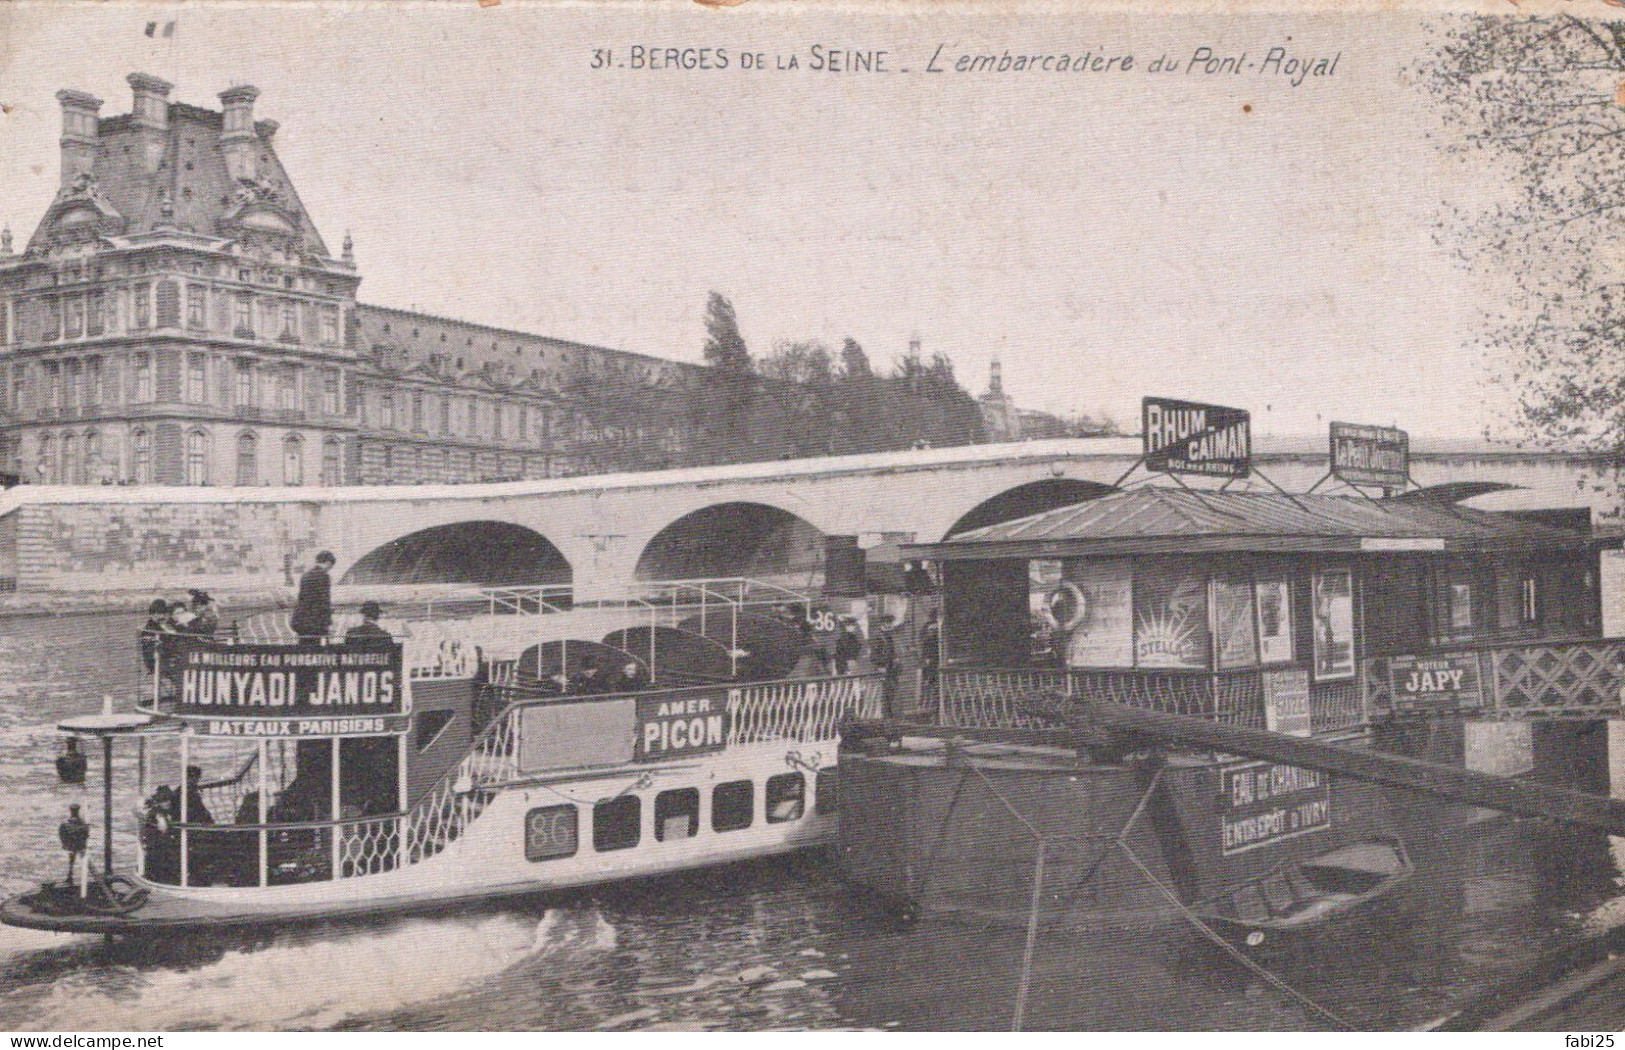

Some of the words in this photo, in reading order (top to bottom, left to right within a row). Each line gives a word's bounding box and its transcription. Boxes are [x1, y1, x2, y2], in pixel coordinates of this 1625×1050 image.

[182, 669, 296, 706] HUNYADI
[309, 670, 394, 706] JANOS
[1405, 669, 1464, 692] JAPY
[209, 720, 291, 736] BATEAUX
[299, 717, 385, 735] PARISIENS
[644, 715, 723, 753] PICON
